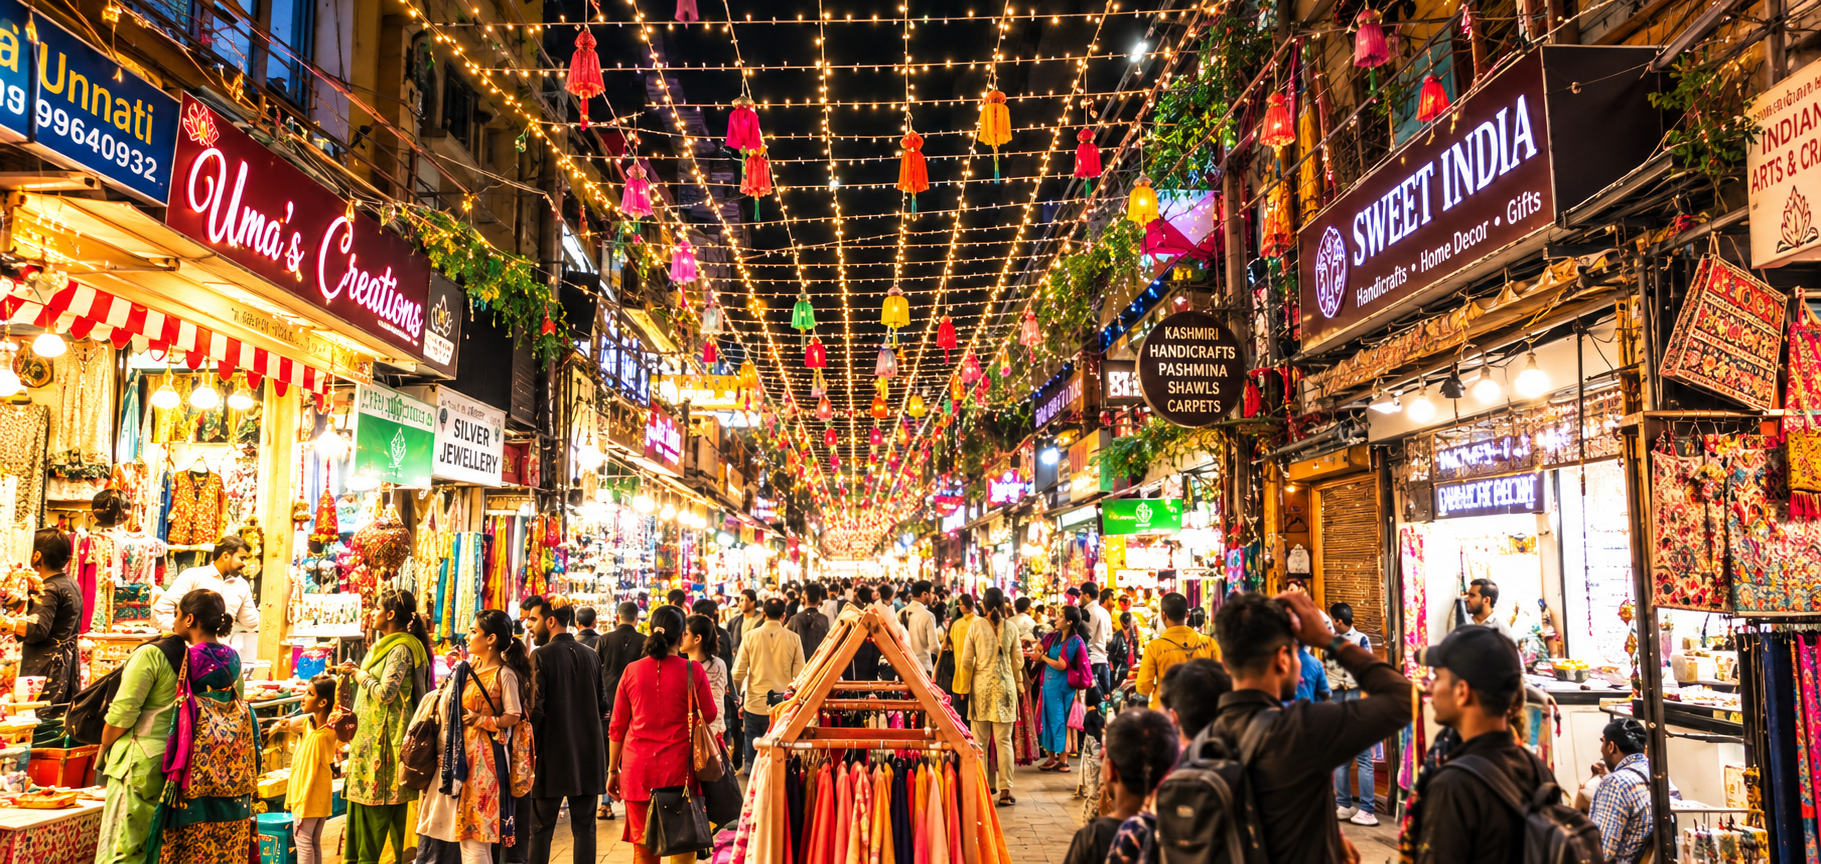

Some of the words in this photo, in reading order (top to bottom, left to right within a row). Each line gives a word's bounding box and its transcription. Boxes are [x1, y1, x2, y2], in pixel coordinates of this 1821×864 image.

[39, 41, 154, 145] Unnati
[35, 99, 157, 183] 99640932
[1353, 160, 1434, 267] SWEET
[1440, 93, 1537, 212] INDIA
[1751, 156, 1783, 194] ARTS
[1787, 150, 1797, 178] &
[1800, 137, 1821, 170] CR
[187, 147, 304, 273] Uma's
[317, 215, 423, 338] Creations
[1356, 263, 1407, 308] Handicrafts
[1420, 242, 1451, 273] Home
[1453, 221, 1489, 255] Decor
[1506, 191, 1542, 225] Gifts
[1165, 326, 1219, 341] KASHMIRI
[1150, 344, 1236, 360] HANDICRAFTS
[1158, 362, 1228, 378] PASHMINA
[1168, 381, 1220, 395] SHAWLS
[1167, 399, 1222, 413] CARPETS
[453, 418, 490, 448] SILVER
[439, 442, 498, 475] JEWELLERY
